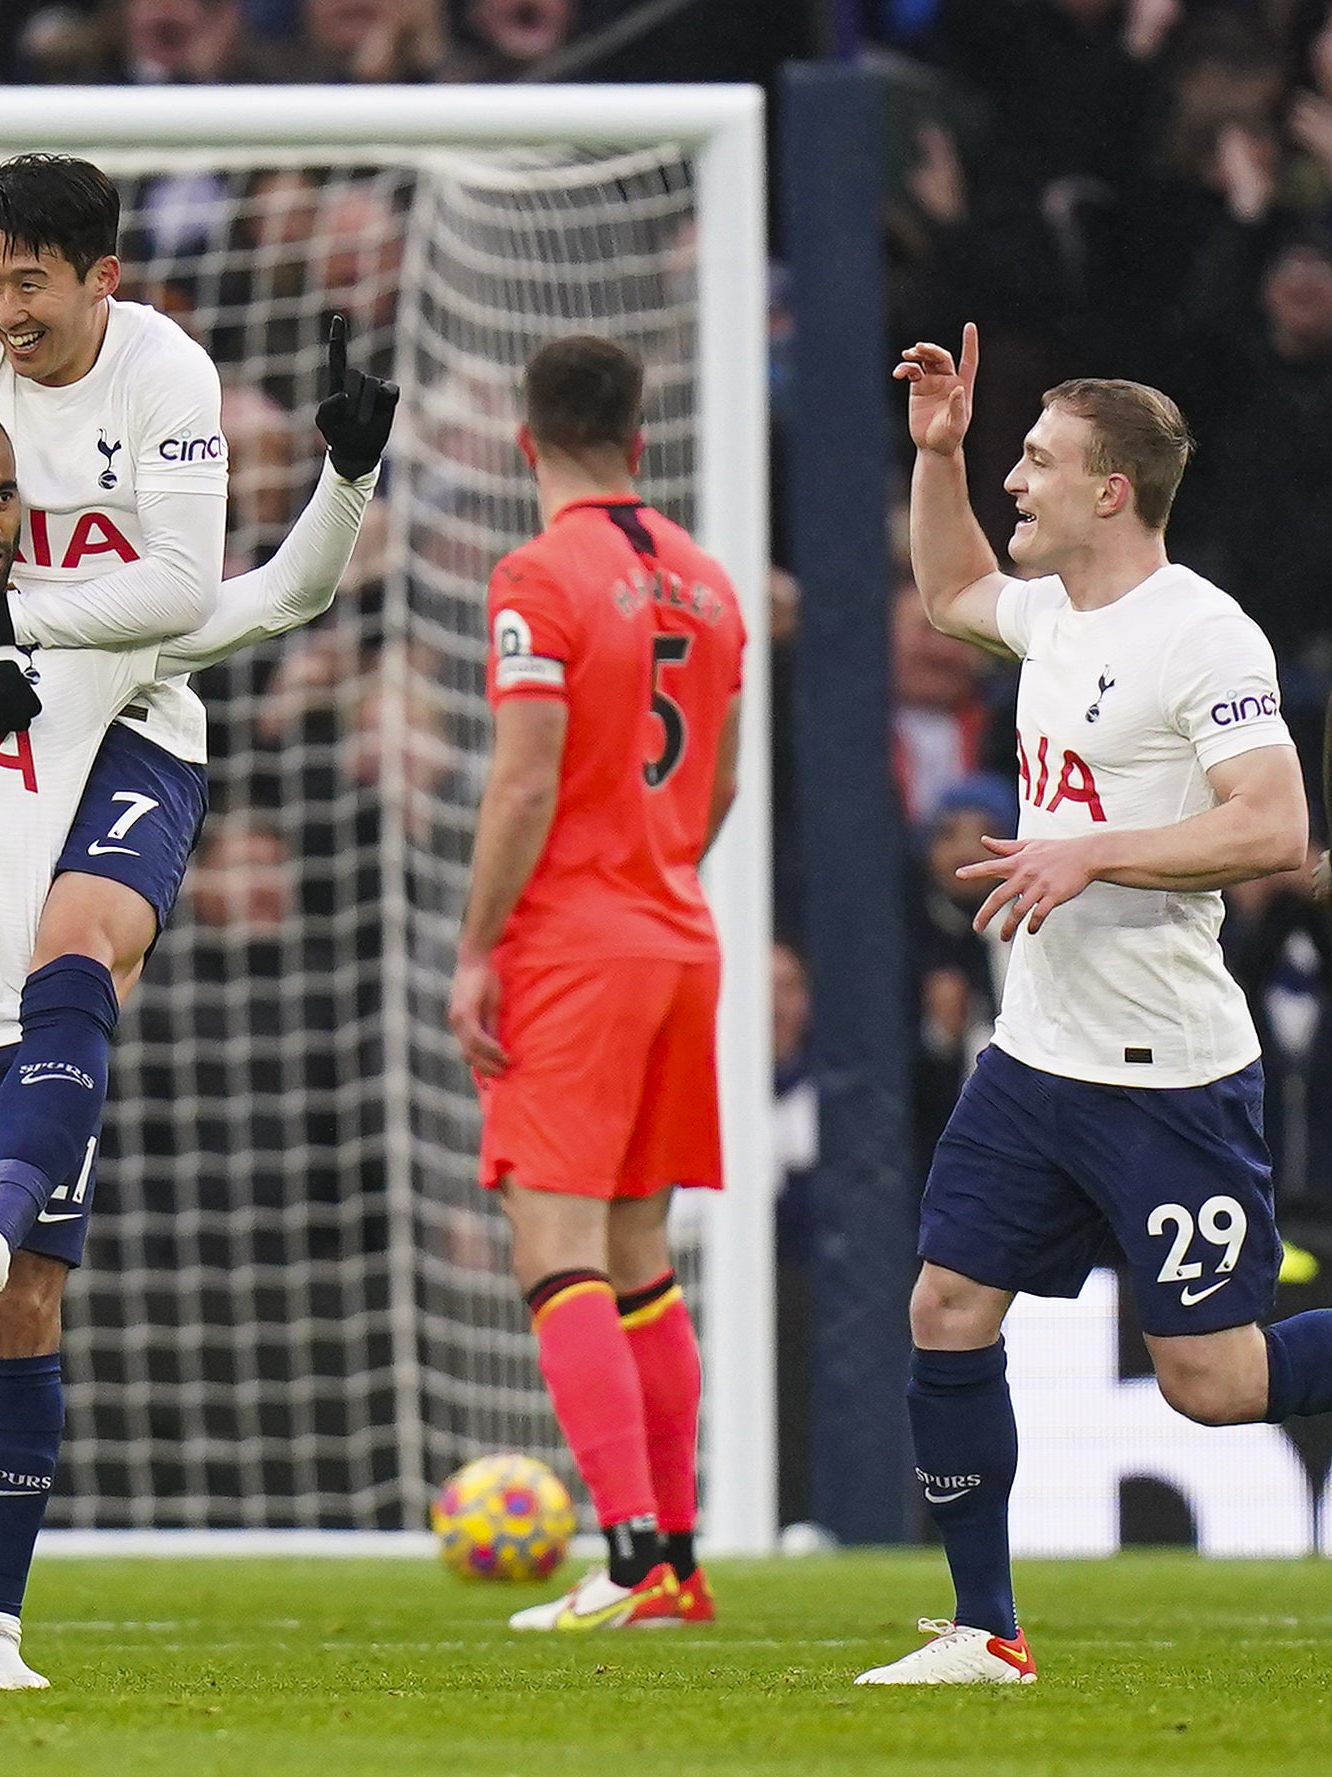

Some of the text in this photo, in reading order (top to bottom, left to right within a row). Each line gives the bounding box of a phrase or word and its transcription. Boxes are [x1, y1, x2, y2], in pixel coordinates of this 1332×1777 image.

[14, 509, 141, 569] IA
[642, 633, 695, 788] 5
[107, 791, 160, 840] 7
[1147, 1195, 1247, 1283] 29
[914, 1466, 982, 1489] SPURS
